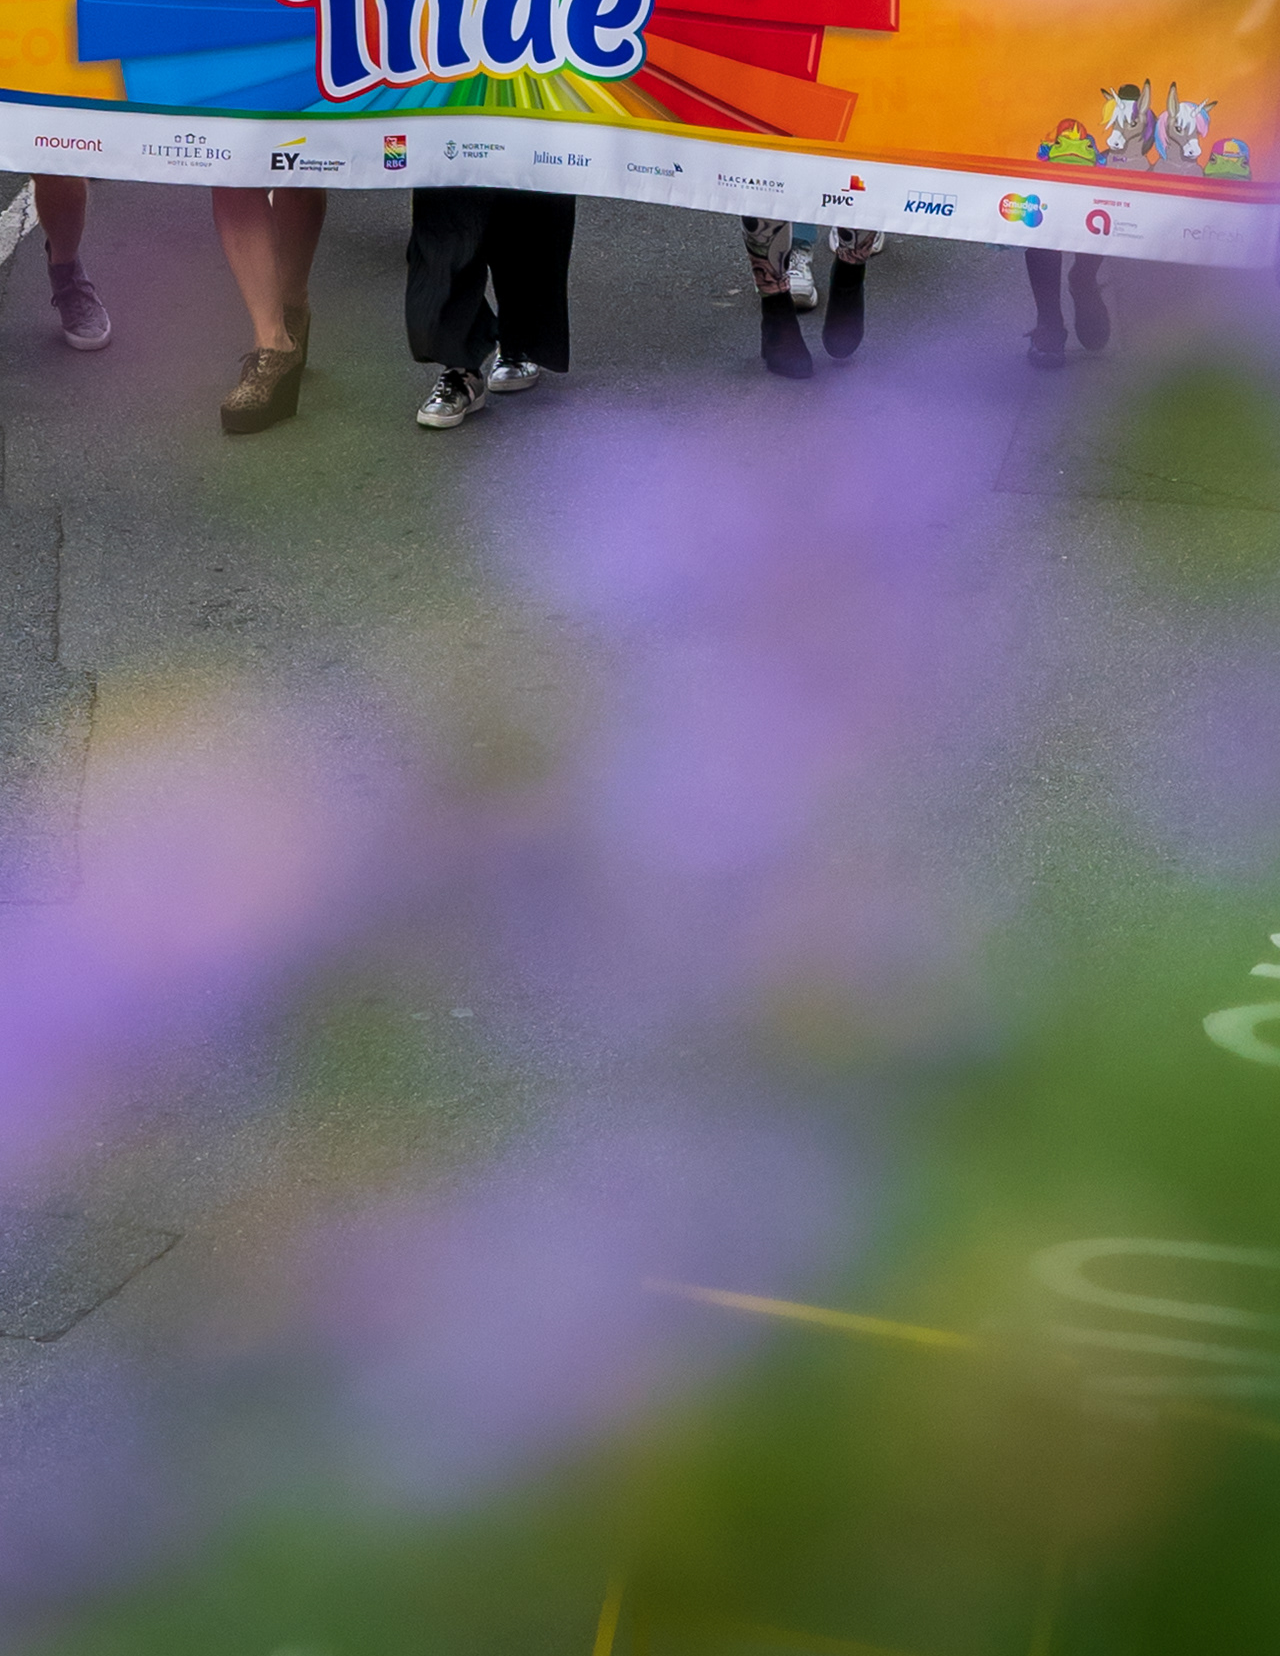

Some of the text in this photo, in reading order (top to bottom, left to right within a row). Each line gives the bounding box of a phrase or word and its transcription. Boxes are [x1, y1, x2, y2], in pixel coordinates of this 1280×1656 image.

[34, 135, 103, 152] mourant
[462, 143, 505, 151] NORTHERN
[148, 144, 202, 158] LITTLE
[206, 148, 232, 161] BIG
[463, 151, 489, 159] TRUST
[533, 150, 593, 167] Julius Bär
[271, 152, 300, 171] EY
[386, 158, 405, 168] RBC
[821, 193, 855, 208] pwc
[904, 200, 955, 217] KPMG
[1002, 198, 1039, 212] Smudge
